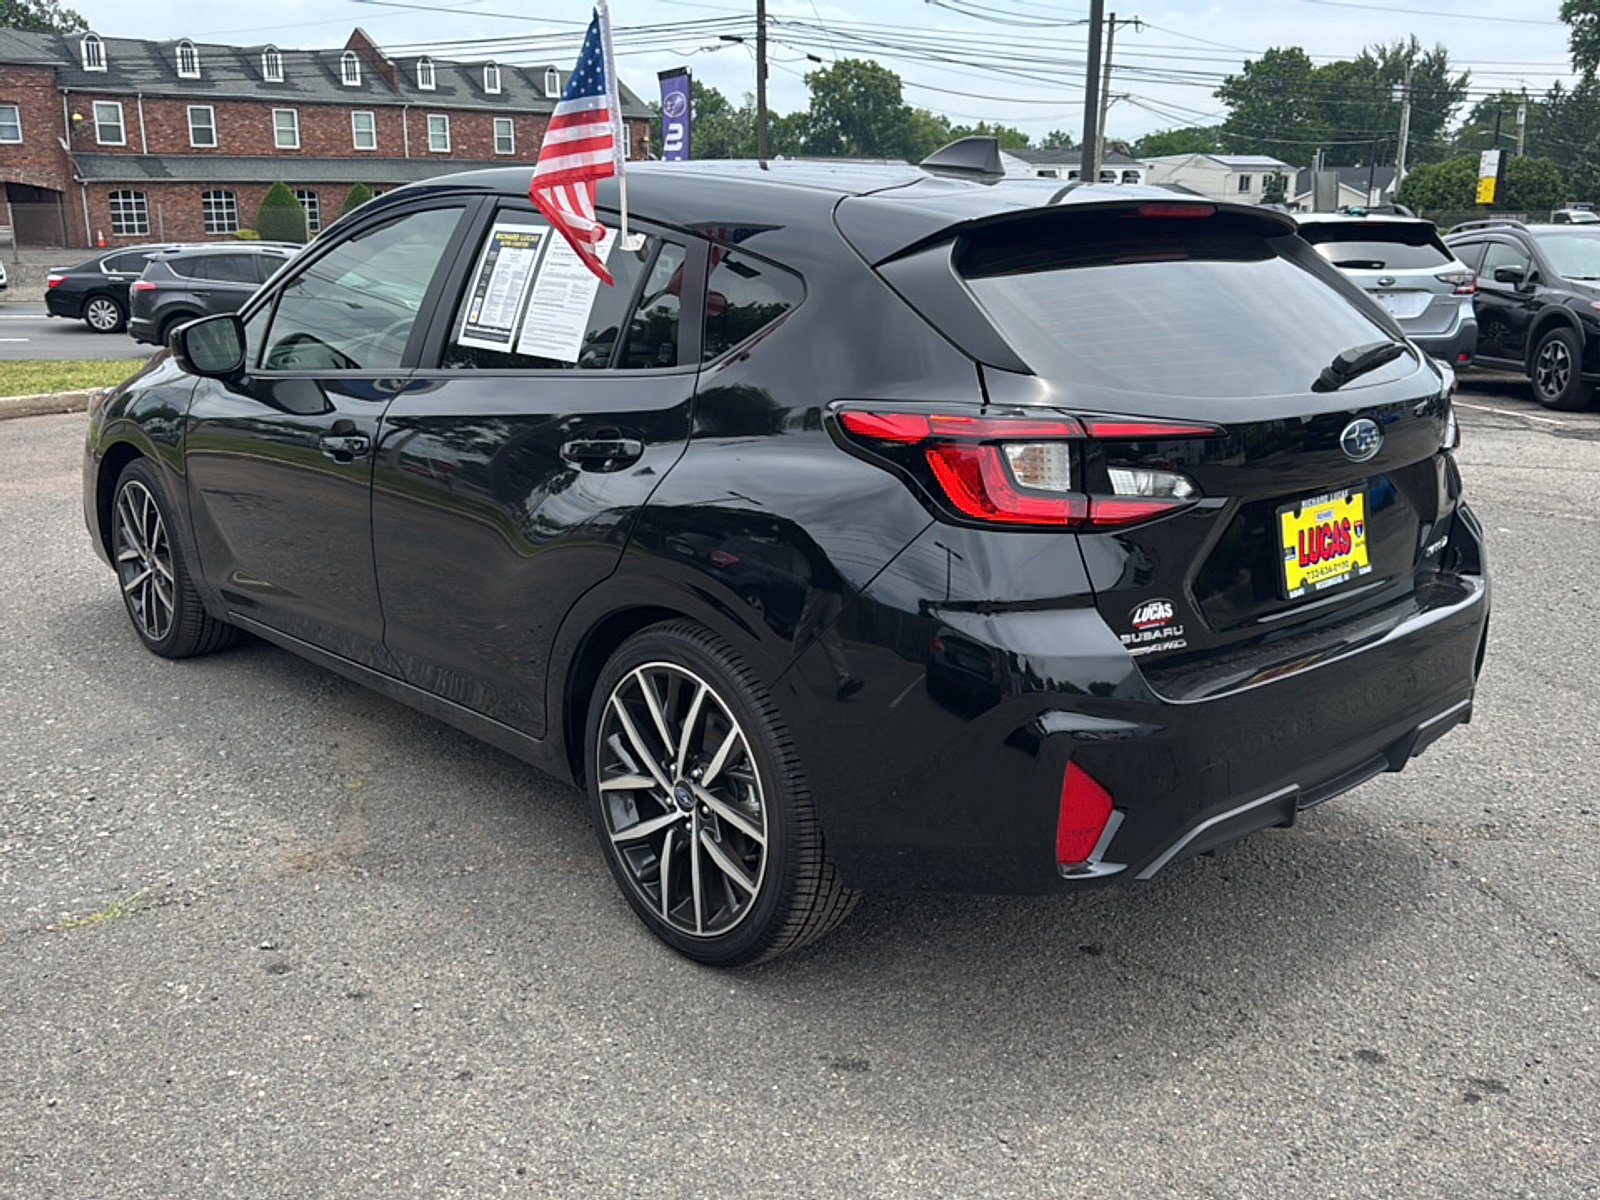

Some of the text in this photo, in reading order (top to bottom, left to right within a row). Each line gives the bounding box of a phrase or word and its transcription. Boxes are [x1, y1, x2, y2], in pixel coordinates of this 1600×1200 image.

[1299, 517, 1351, 568] LUCAS
[1132, 603, 1173, 624] LUCAS
[1120, 625, 1184, 644] SUBARU
[1146, 639, 1187, 654] AWD
